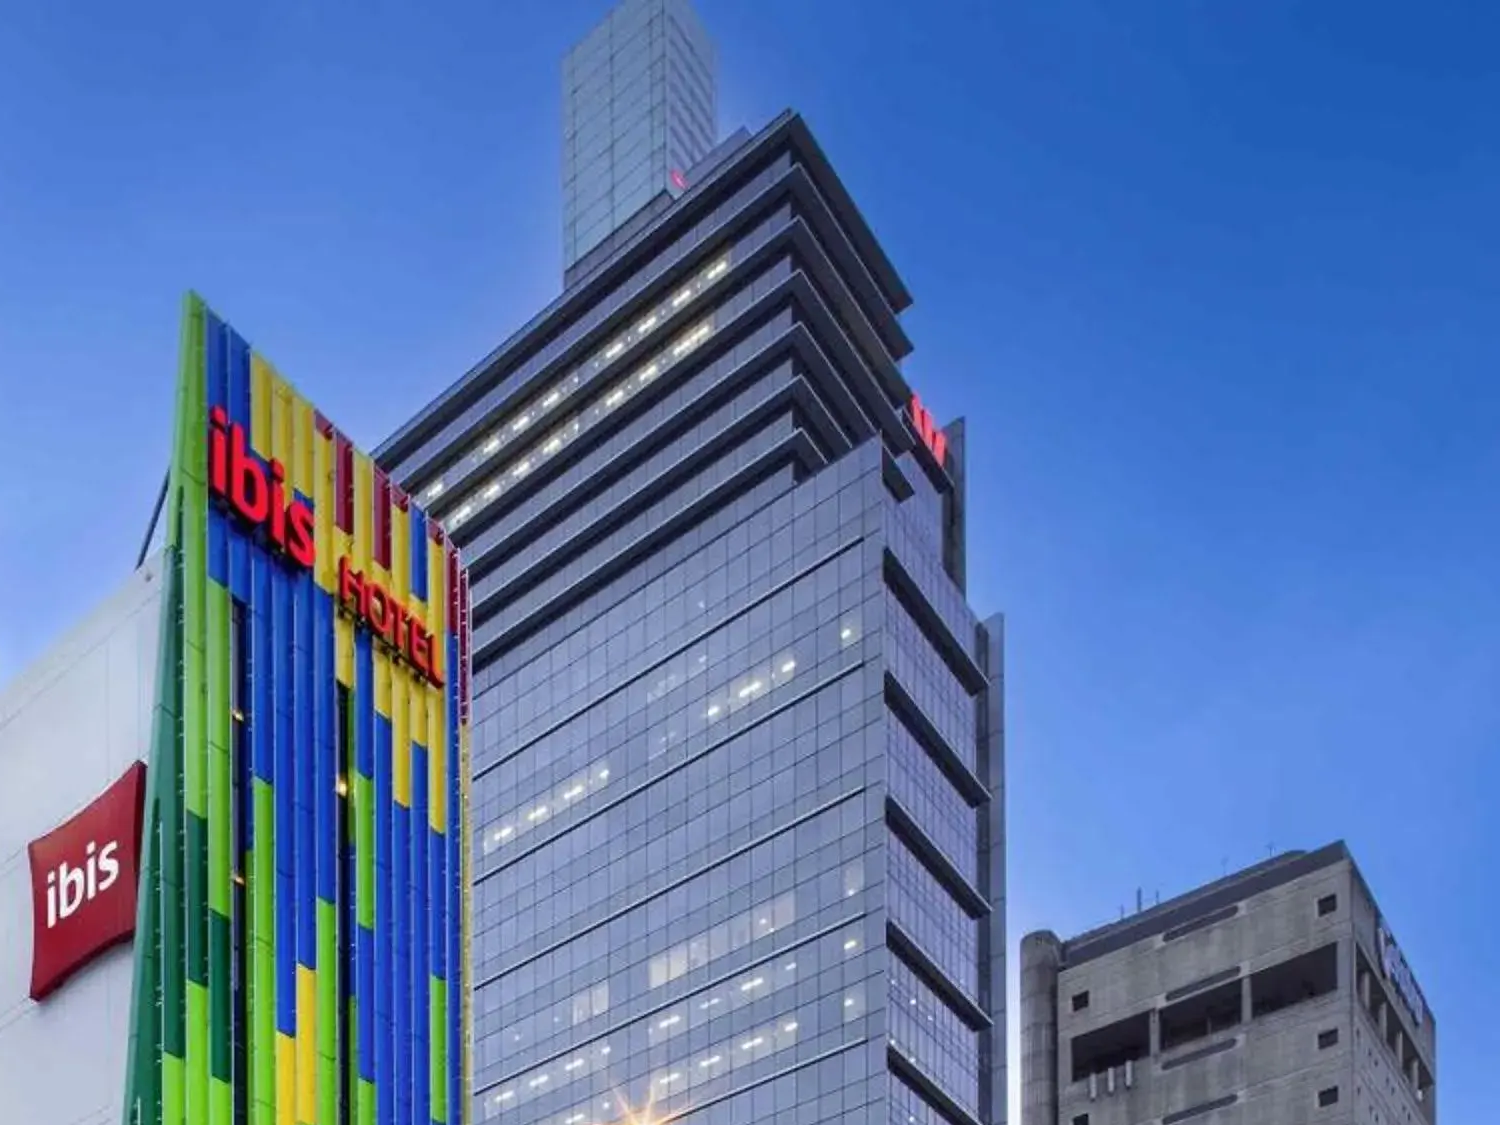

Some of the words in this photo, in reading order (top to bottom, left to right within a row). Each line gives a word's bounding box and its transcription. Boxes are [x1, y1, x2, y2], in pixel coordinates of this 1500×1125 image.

[210, 406, 315, 567] ibis
[338, 555, 445, 689] HOTEL
[47, 841, 119, 928] ibis
